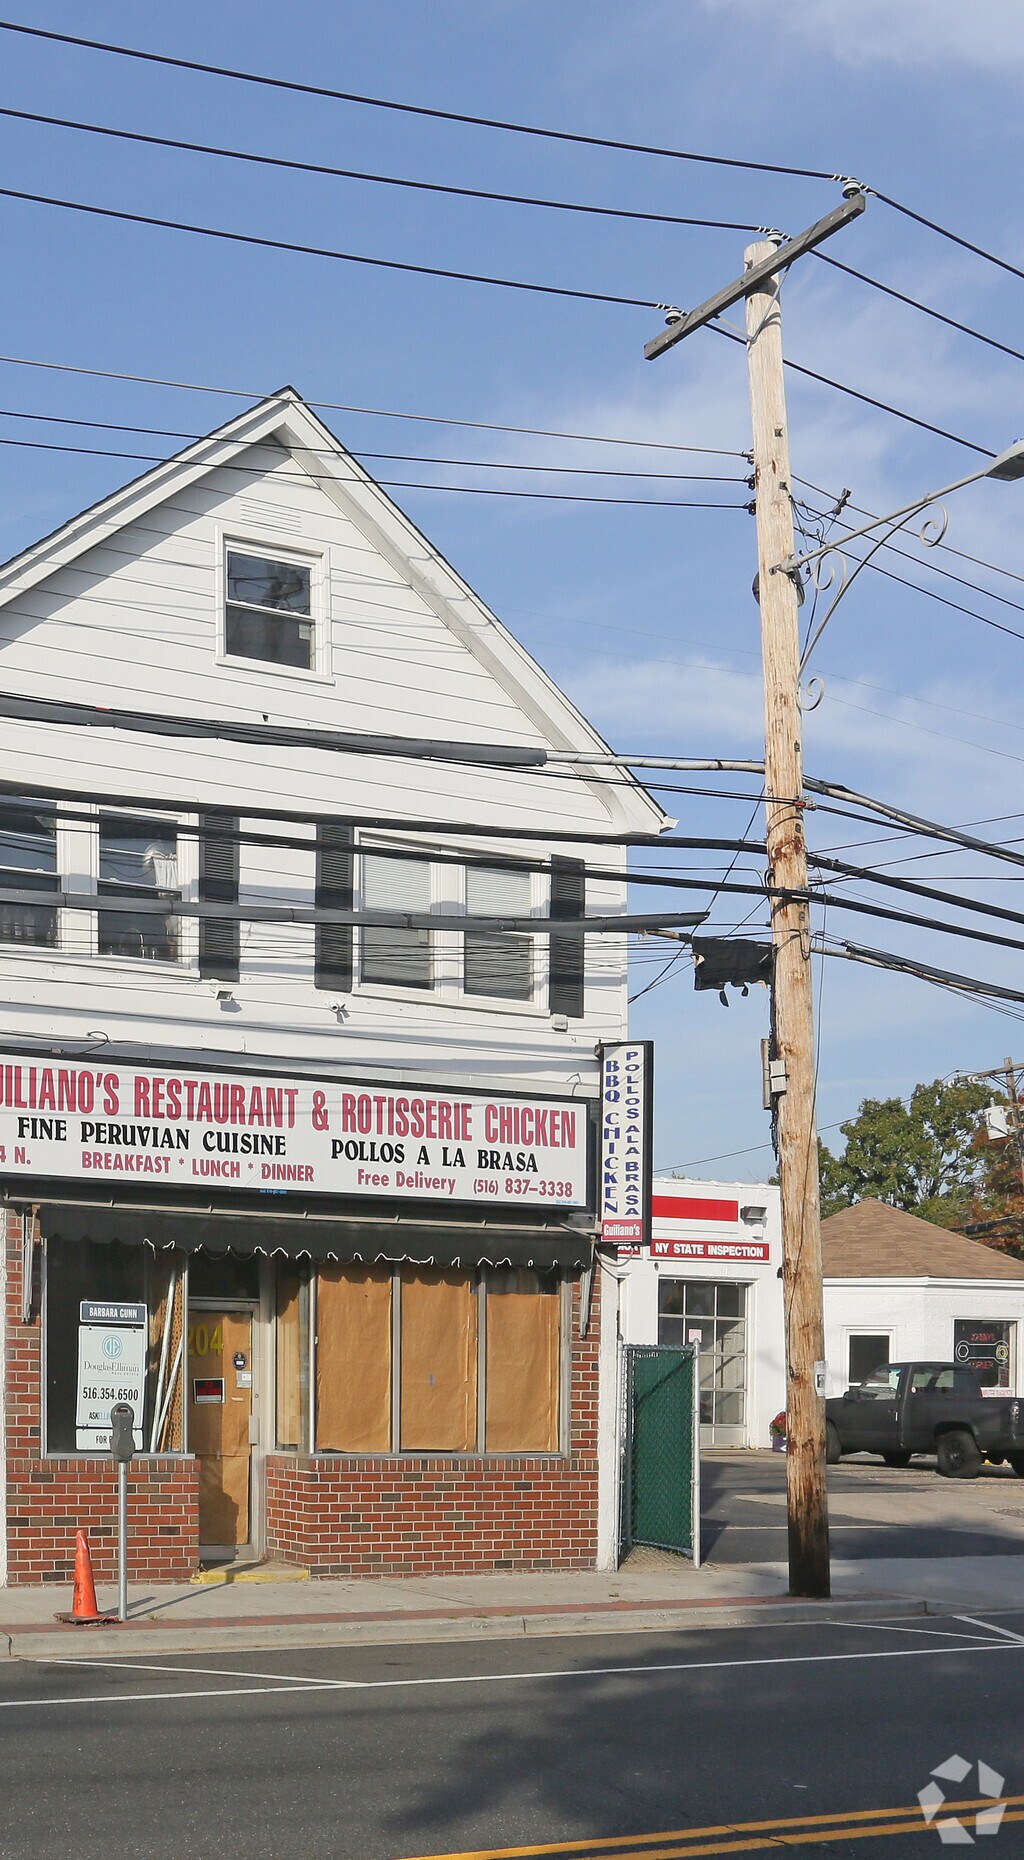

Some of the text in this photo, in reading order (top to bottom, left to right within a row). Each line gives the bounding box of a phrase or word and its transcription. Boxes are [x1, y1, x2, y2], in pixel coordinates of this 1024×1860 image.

[624, 1051, 640, 1119] POLLOS
[134, 1075, 298, 1129] RESTAURANT
[311, 1089, 330, 1132] &
[341, 1092, 473, 1142] ROTISSERIE
[485, 1104, 576, 1149] CHICKEN
[17, 1116, 287, 1156] FINE PERUVIAN CUISINE
[603, 1060, 620, 1213] BBQ CHICKEN
[14, 1146, 32, 1165] N.
[81, 1151, 315, 1182] BREAKFAST LUNCH DINNER
[331, 1139, 538, 1172] POLLOS A LA BRASA
[357, 1169, 573, 1198] Free Delivery (516) 837-3338
[624, 1162, 640, 1216] BRASA
[603, 1224, 641, 1236] Guiliano's
[655, 1242, 764, 1258] NY STATE INSPECTION
[89, 1307, 138, 1319] BARBARA GUNN
[82, 1386, 139, 1401] 516.354.6500
[95, 1435, 108, 1444] FOR
